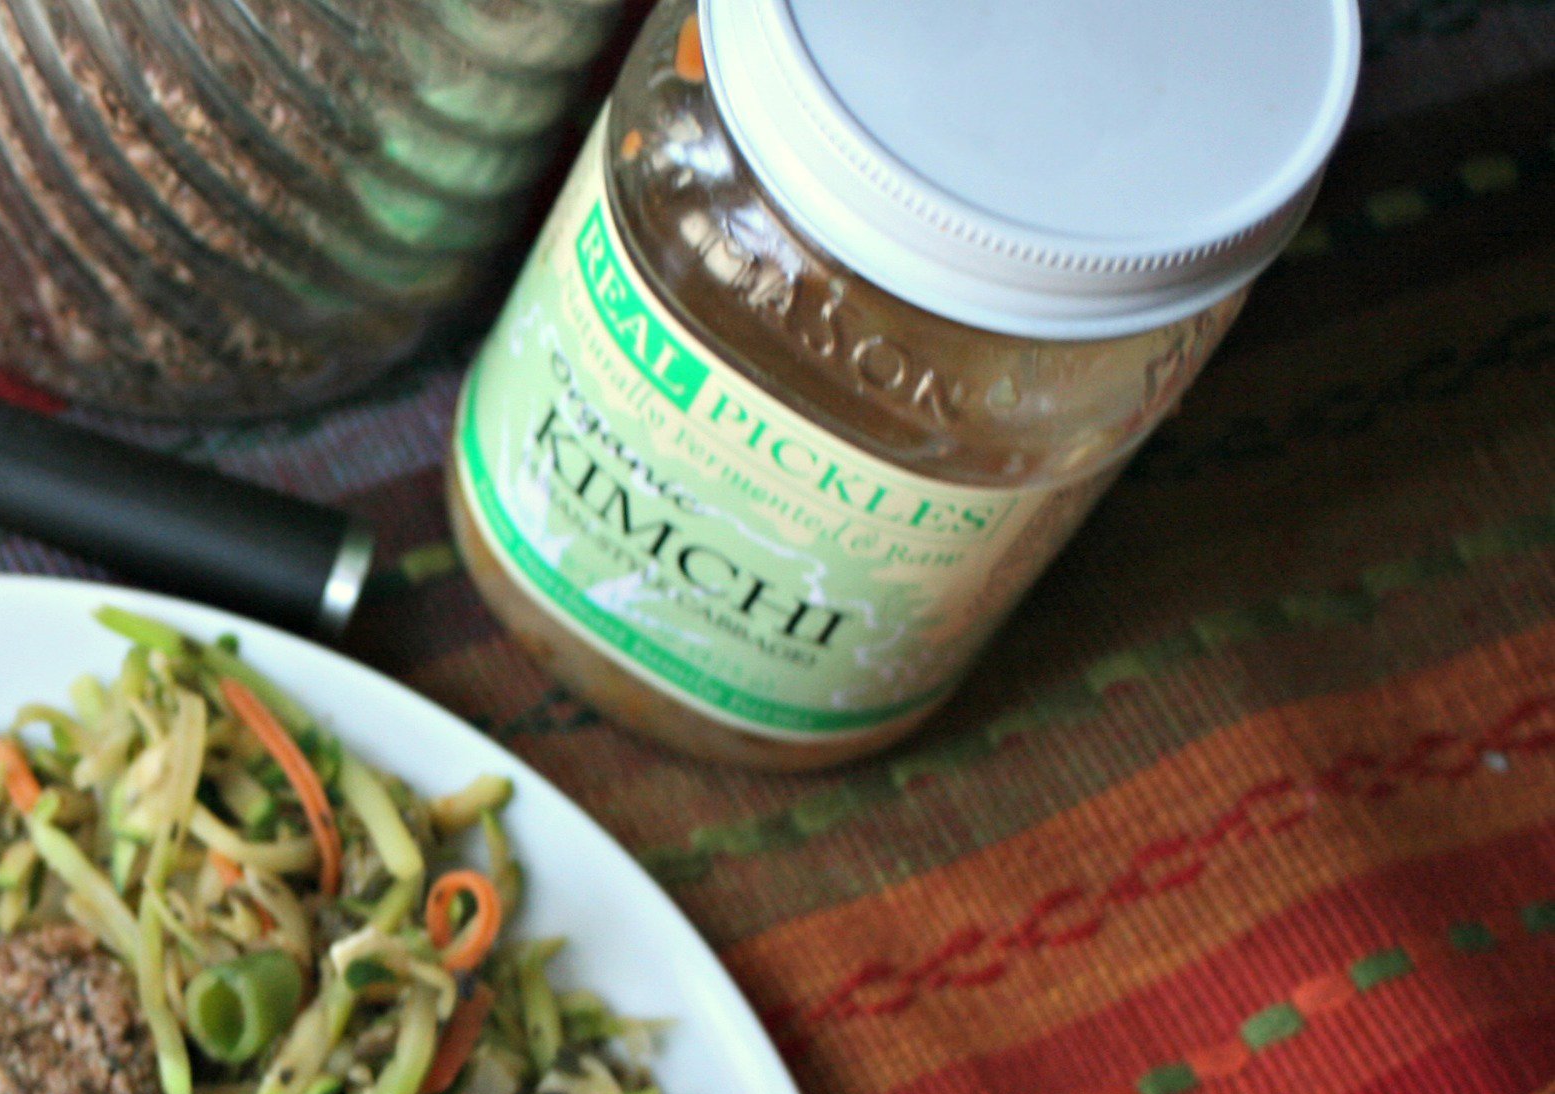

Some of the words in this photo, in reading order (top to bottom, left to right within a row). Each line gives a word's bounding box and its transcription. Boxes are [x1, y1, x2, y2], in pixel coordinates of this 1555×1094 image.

[550, 350, 697, 513] Organic
[578, 210, 688, 398] REAL
[707, 393, 994, 532] PICKLES
[533, 402, 850, 648] KIMCHI
